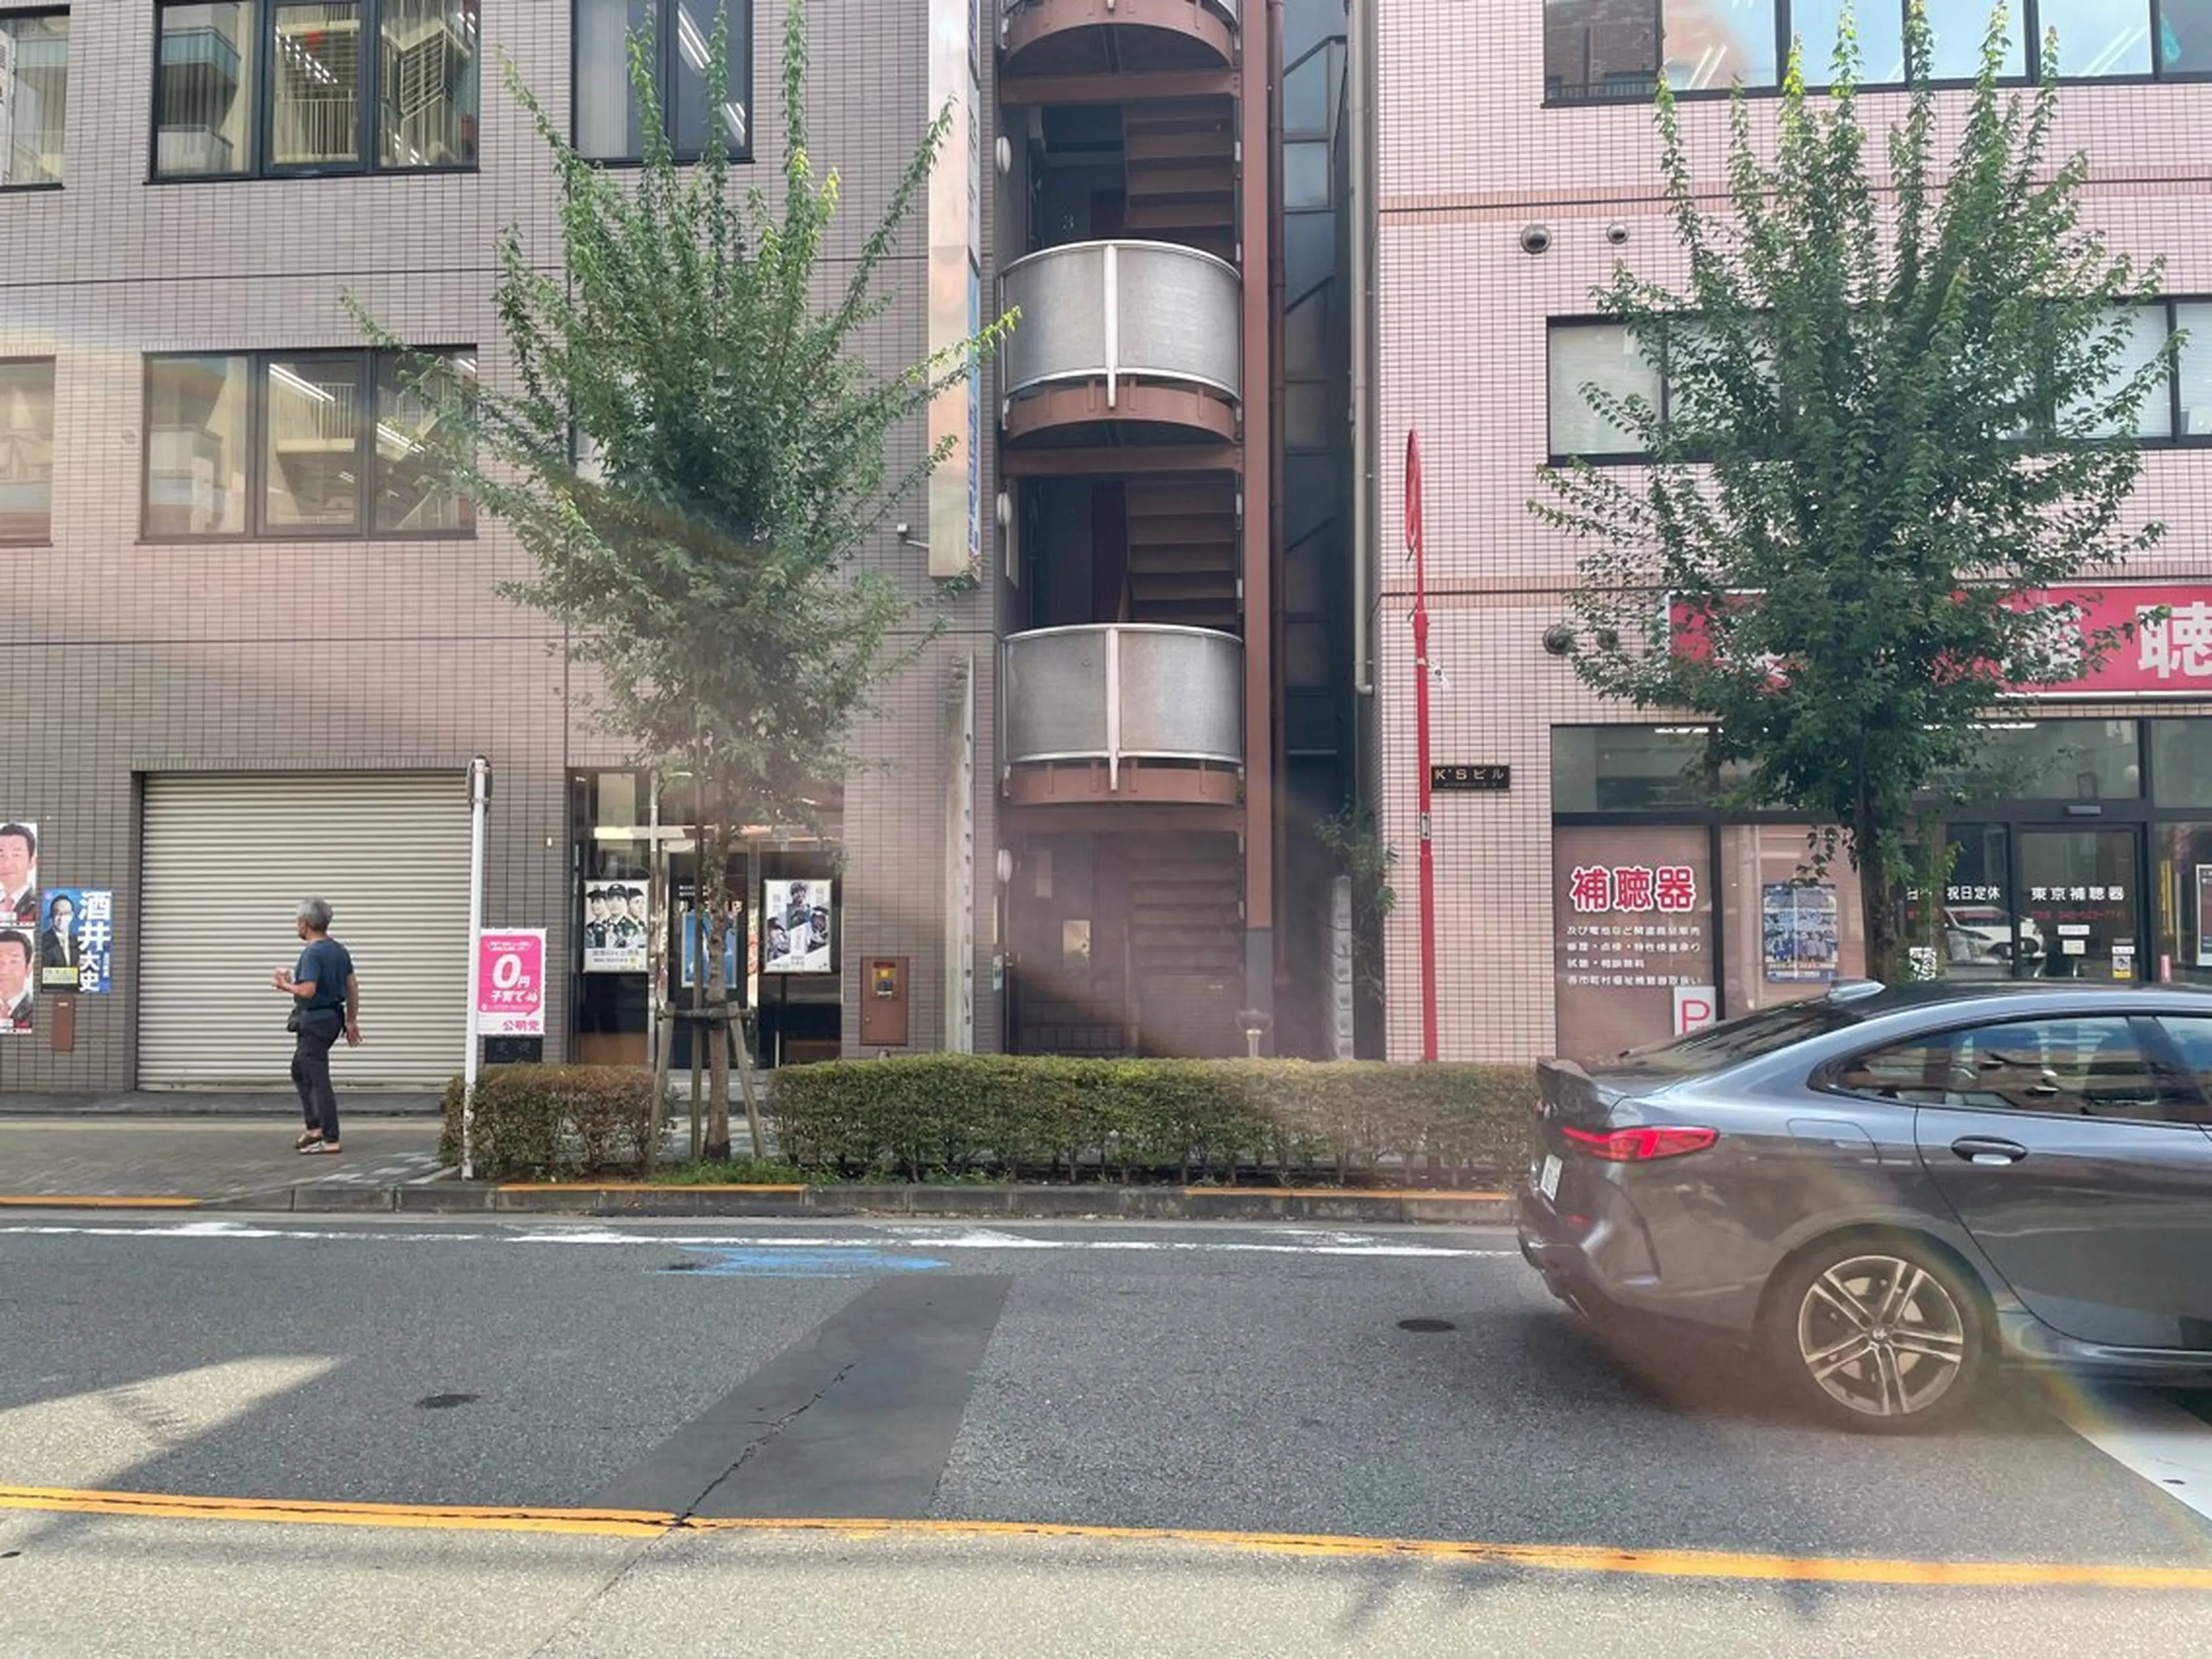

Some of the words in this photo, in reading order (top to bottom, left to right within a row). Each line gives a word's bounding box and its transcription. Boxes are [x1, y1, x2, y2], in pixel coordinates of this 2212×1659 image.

[1570, 866, 1696, 912] 補聴器
[2031, 886, 2124, 900] 東京補聴器
[78, 891, 112, 992] 酒井大史
[493, 953, 531, 989] 0円
[502, 1020, 540, 1031] 公明党
[1681, 1000, 1711, 1035] P
